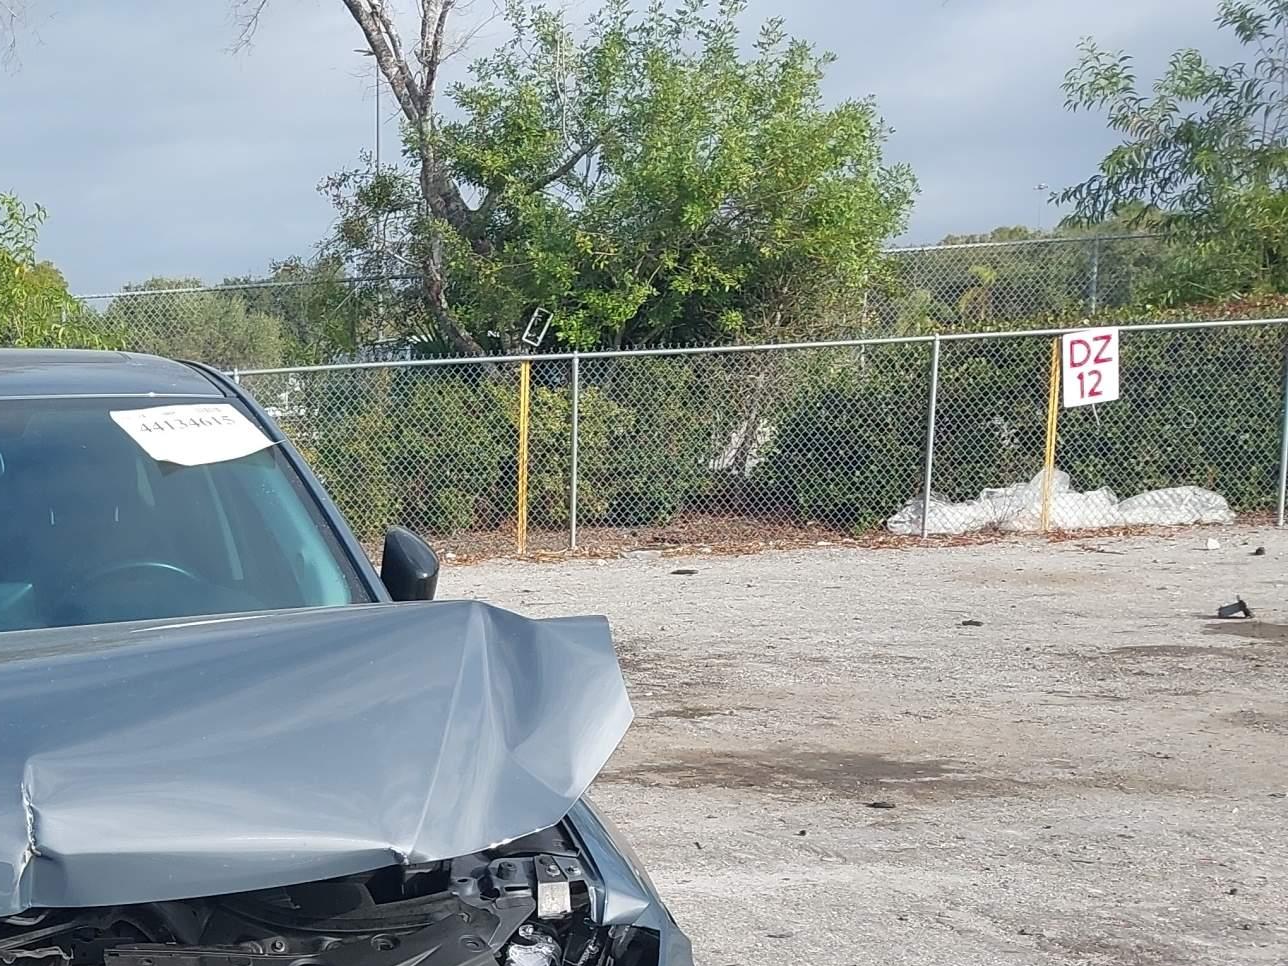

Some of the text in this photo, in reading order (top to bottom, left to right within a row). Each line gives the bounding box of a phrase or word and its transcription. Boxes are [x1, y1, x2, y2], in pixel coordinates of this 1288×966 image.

[1069, 334, 1113, 368] DZ
[1077, 369, 1103, 399] 12
[139, 415, 236, 434] 44134615
